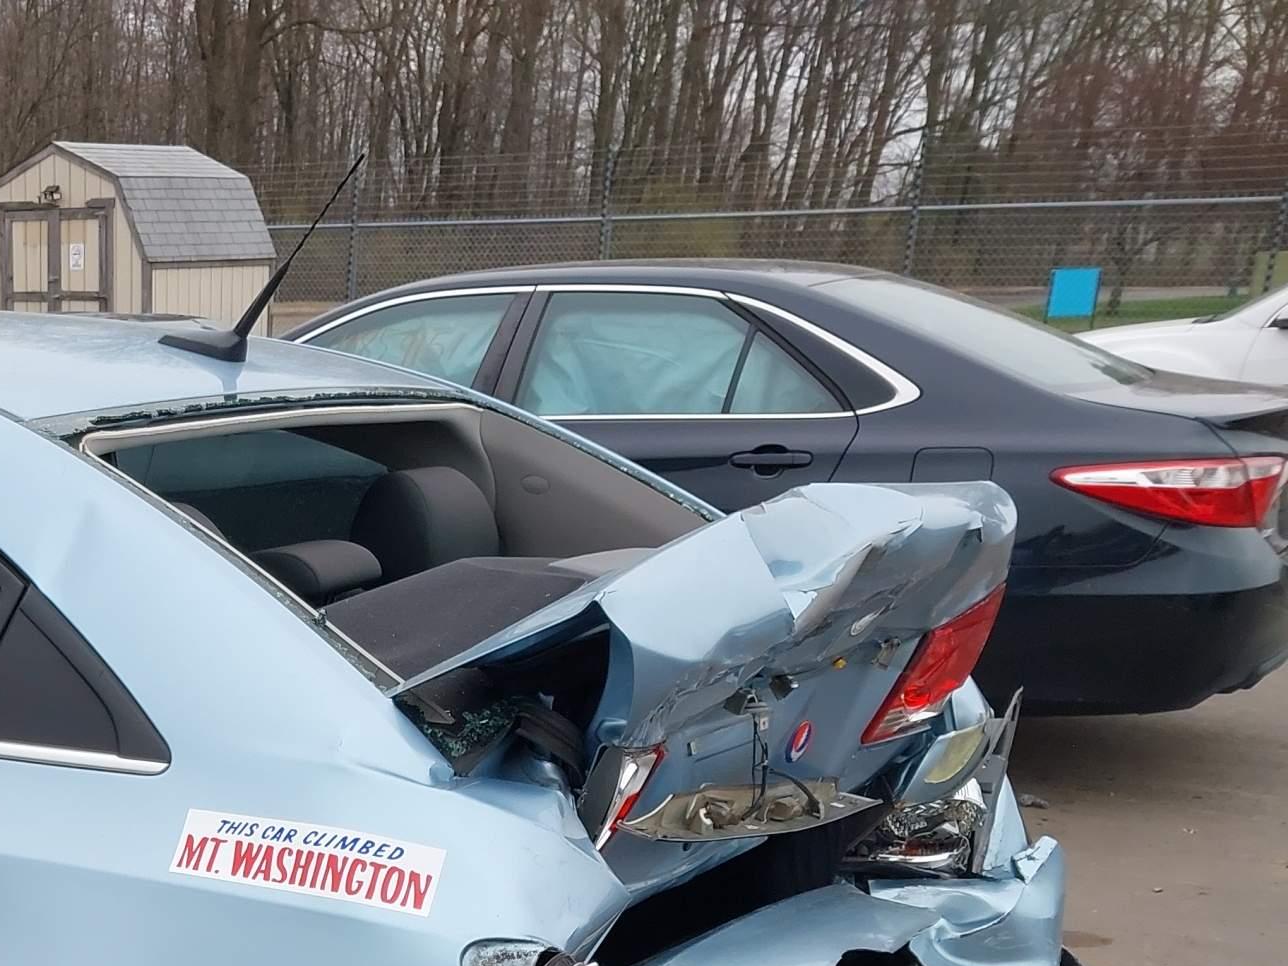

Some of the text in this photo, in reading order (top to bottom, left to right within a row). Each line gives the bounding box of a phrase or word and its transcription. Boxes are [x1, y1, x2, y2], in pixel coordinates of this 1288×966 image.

[216, 819, 405, 860] THIS CAR CLIMBED
[176, 833, 433, 910] MT. WASHINGTON
